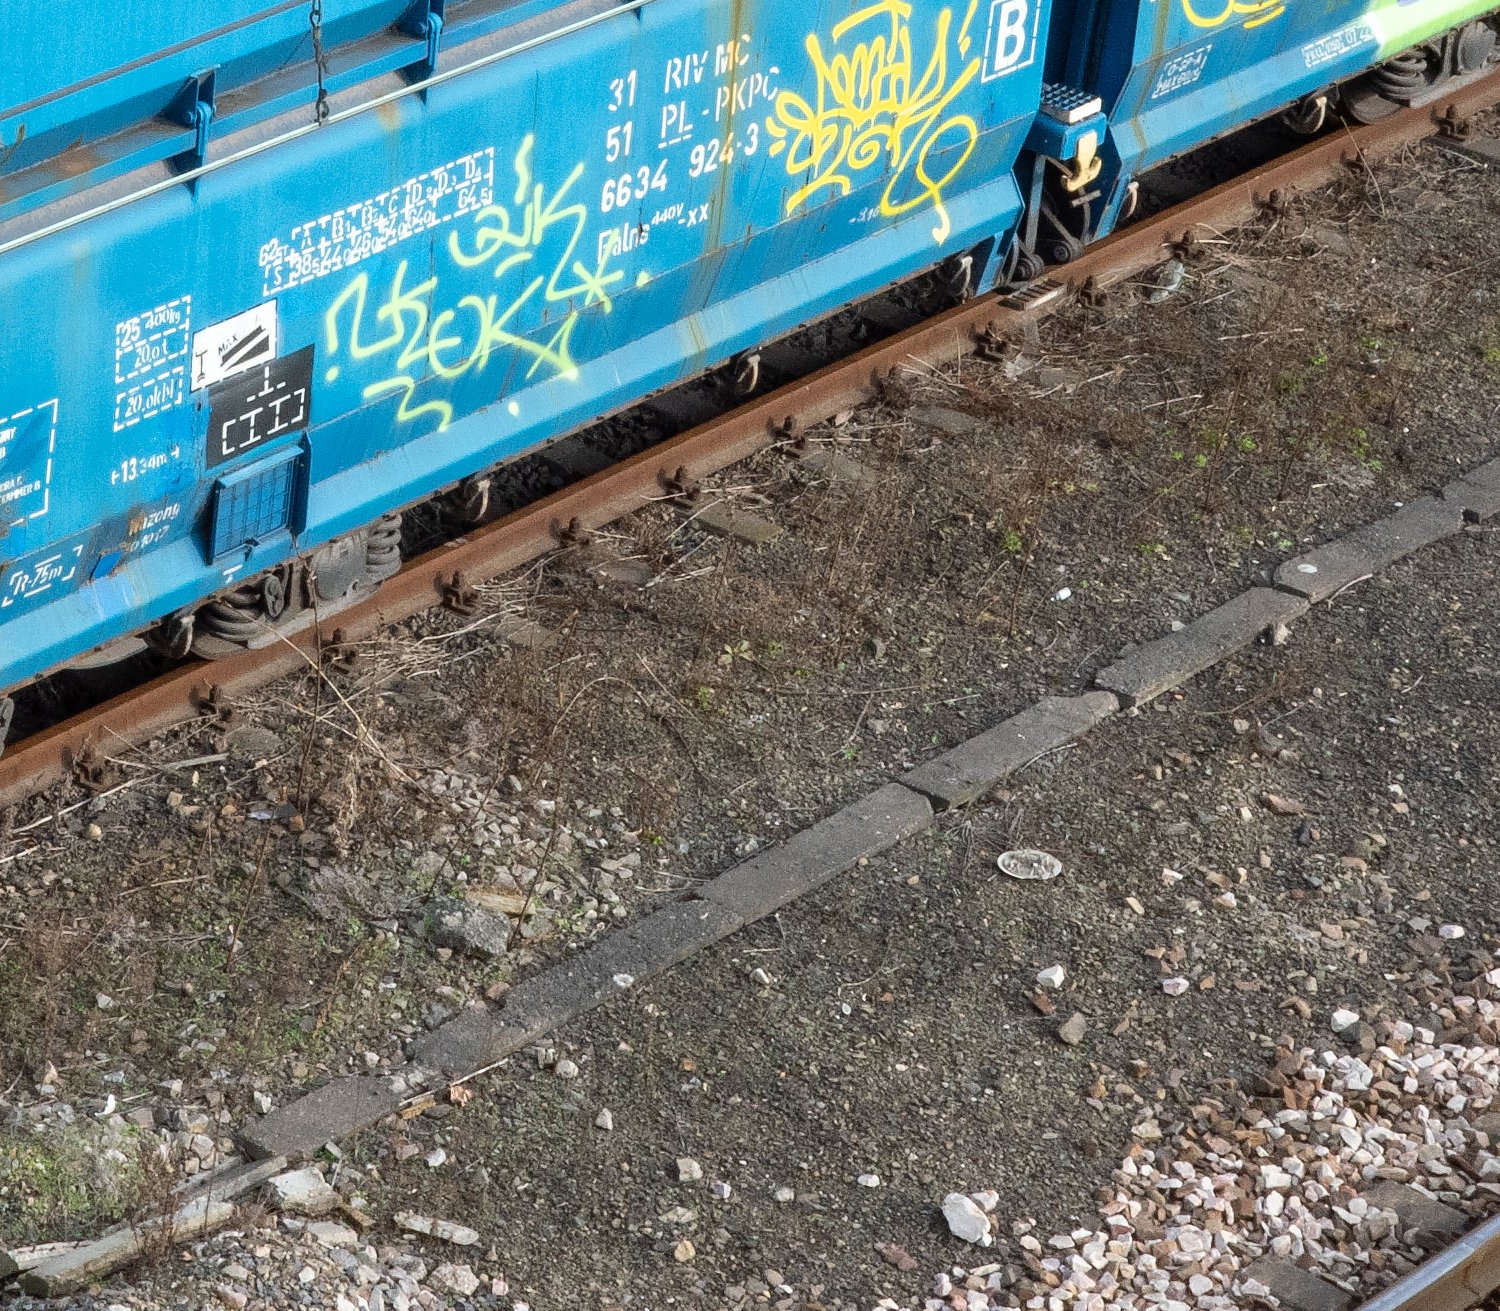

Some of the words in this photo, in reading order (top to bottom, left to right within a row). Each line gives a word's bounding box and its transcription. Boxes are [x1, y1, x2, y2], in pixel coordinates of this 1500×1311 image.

[607, 69, 637, 112] 31
[664, 50, 709, 94] RIV
[605, 120, 633, 163] 51
[601, 158, 669, 213] 6634
